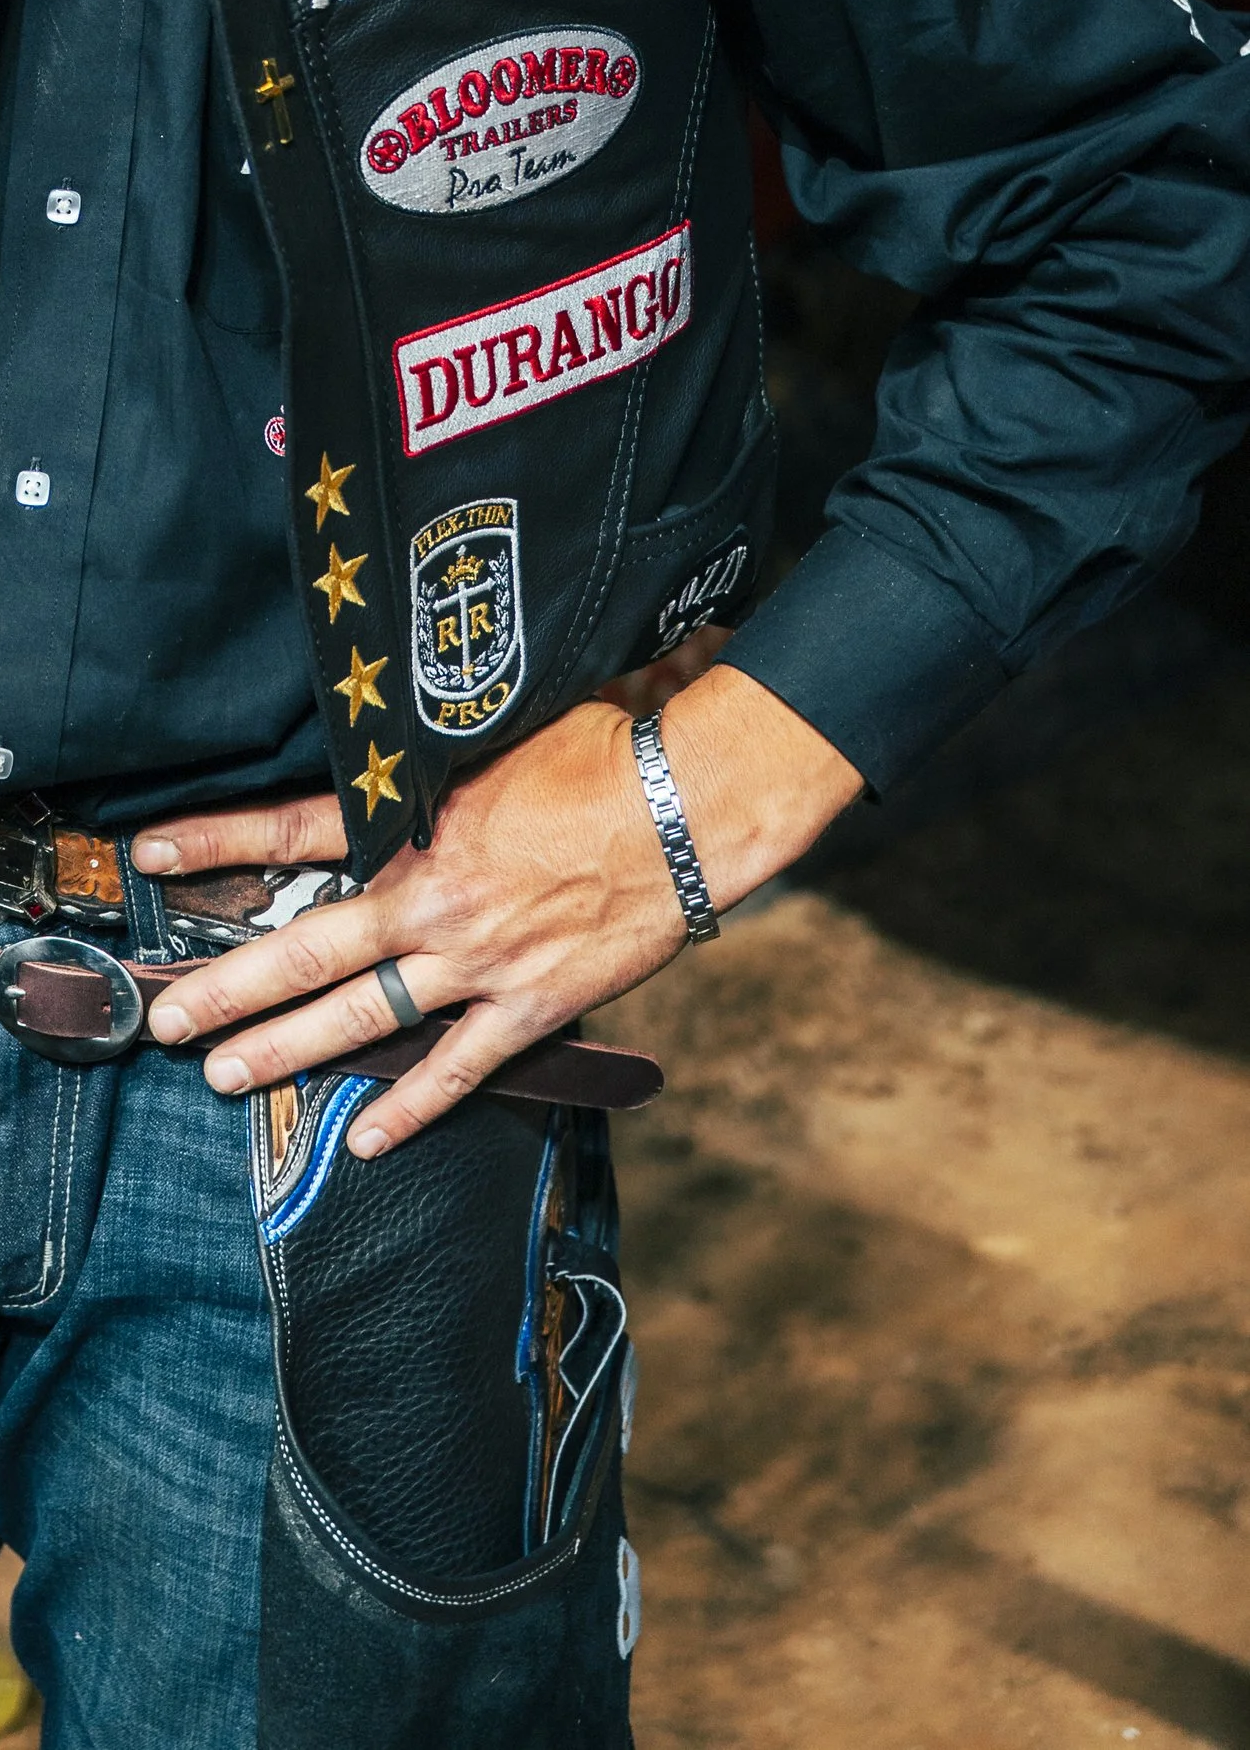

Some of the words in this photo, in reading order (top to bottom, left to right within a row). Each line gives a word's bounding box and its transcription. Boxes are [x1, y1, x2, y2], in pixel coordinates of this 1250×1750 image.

[397, 46, 610, 156] BLOOMER
[439, 99, 579, 162] TRAILERS
[445, 165, 503, 209] Pro
[508, 146, 578, 187] Team
[409, 257, 682, 432] DURANGO
[434, 681, 511, 727] PRO
